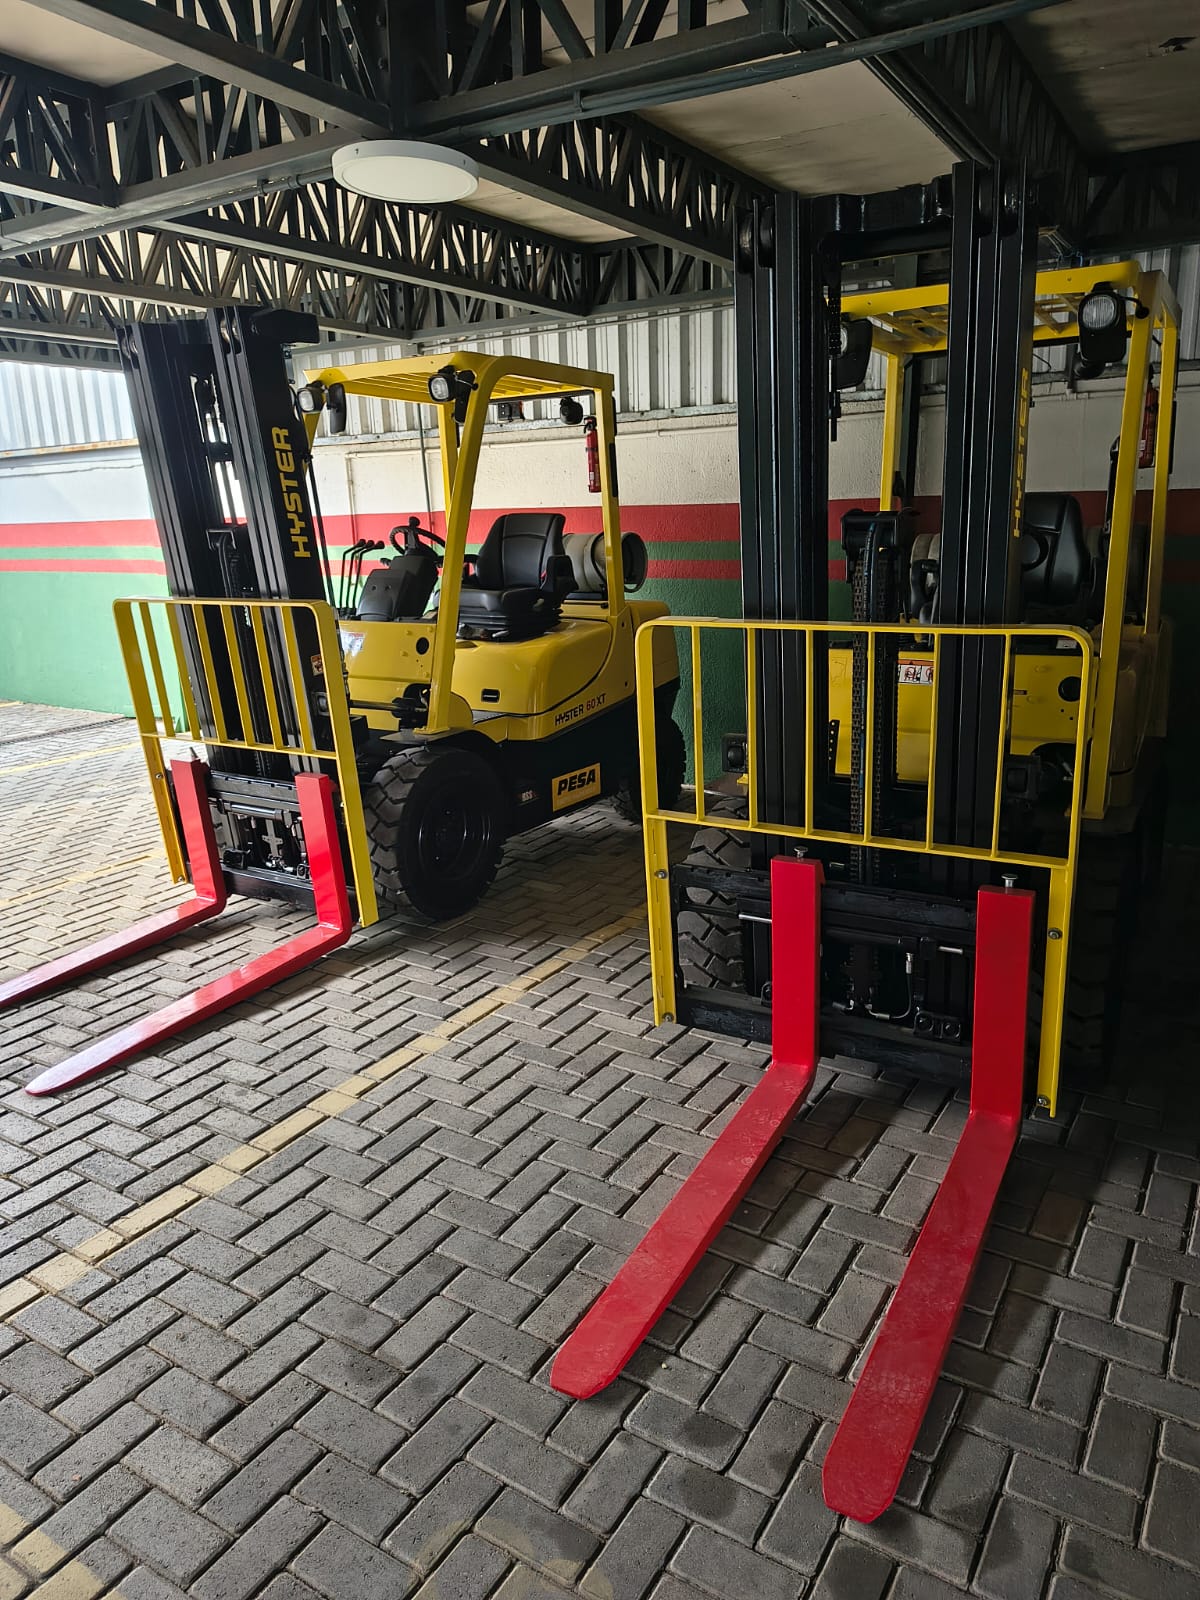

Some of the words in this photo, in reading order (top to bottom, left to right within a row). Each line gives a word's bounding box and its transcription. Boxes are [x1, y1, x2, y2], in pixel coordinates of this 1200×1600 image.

[1013, 367, 1028, 537] HYSTER
[271, 426, 311, 558] HYSTER
[555, 704, 583, 726] HYSTER
[557, 768, 596, 795] PESA
